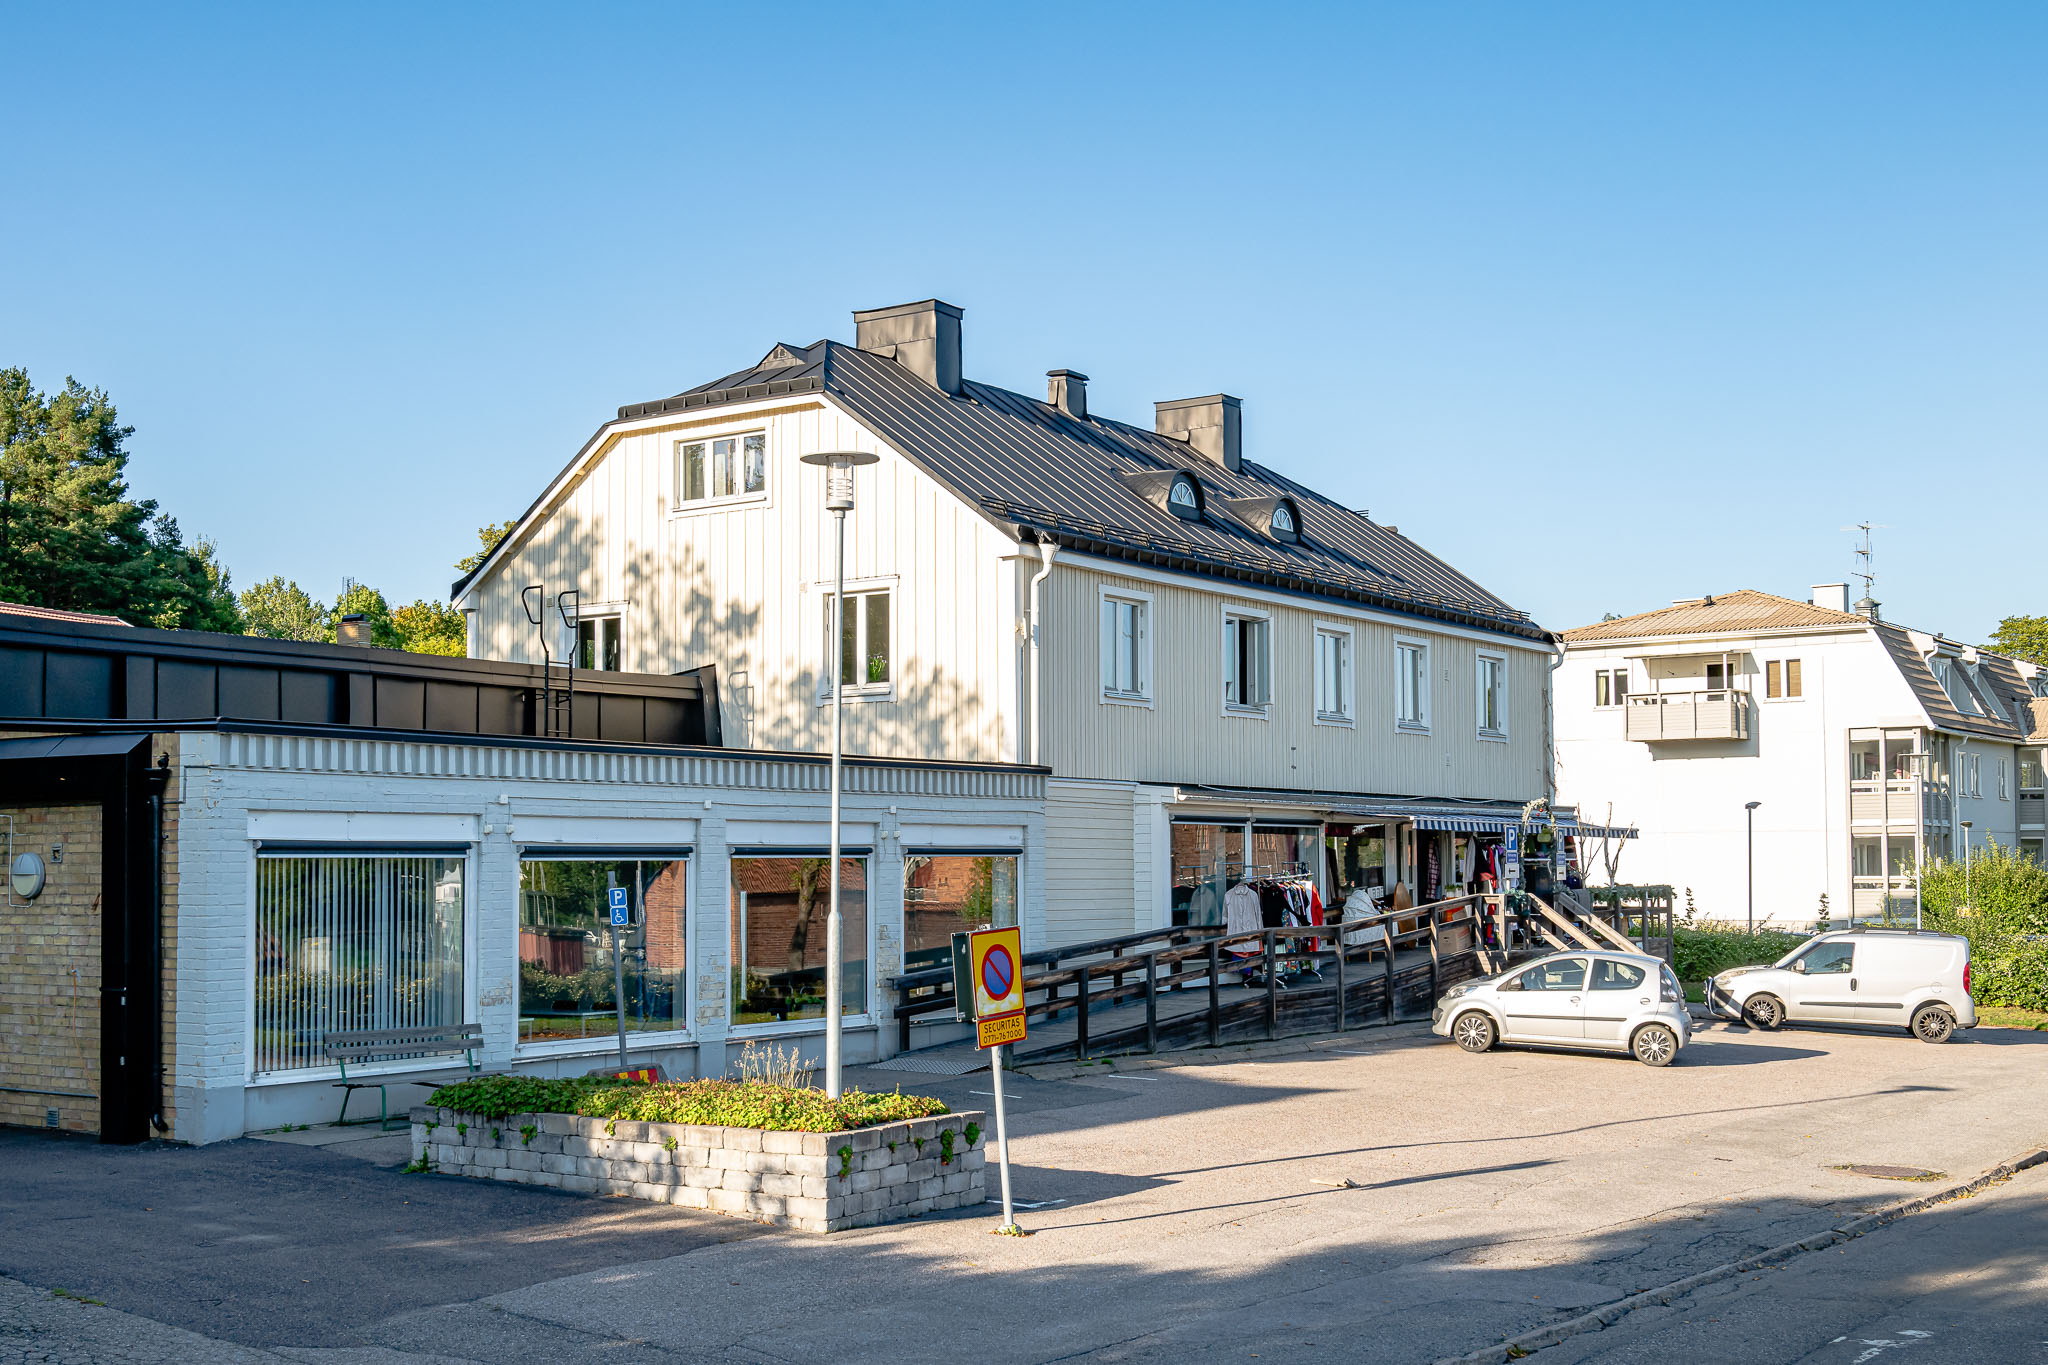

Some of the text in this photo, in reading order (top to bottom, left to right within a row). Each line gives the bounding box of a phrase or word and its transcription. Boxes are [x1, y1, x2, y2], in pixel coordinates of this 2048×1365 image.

[1508, 828, 1516, 848] P
[614, 890, 622, 904] P
[984, 1018, 1020, 1034] SECURITAS
